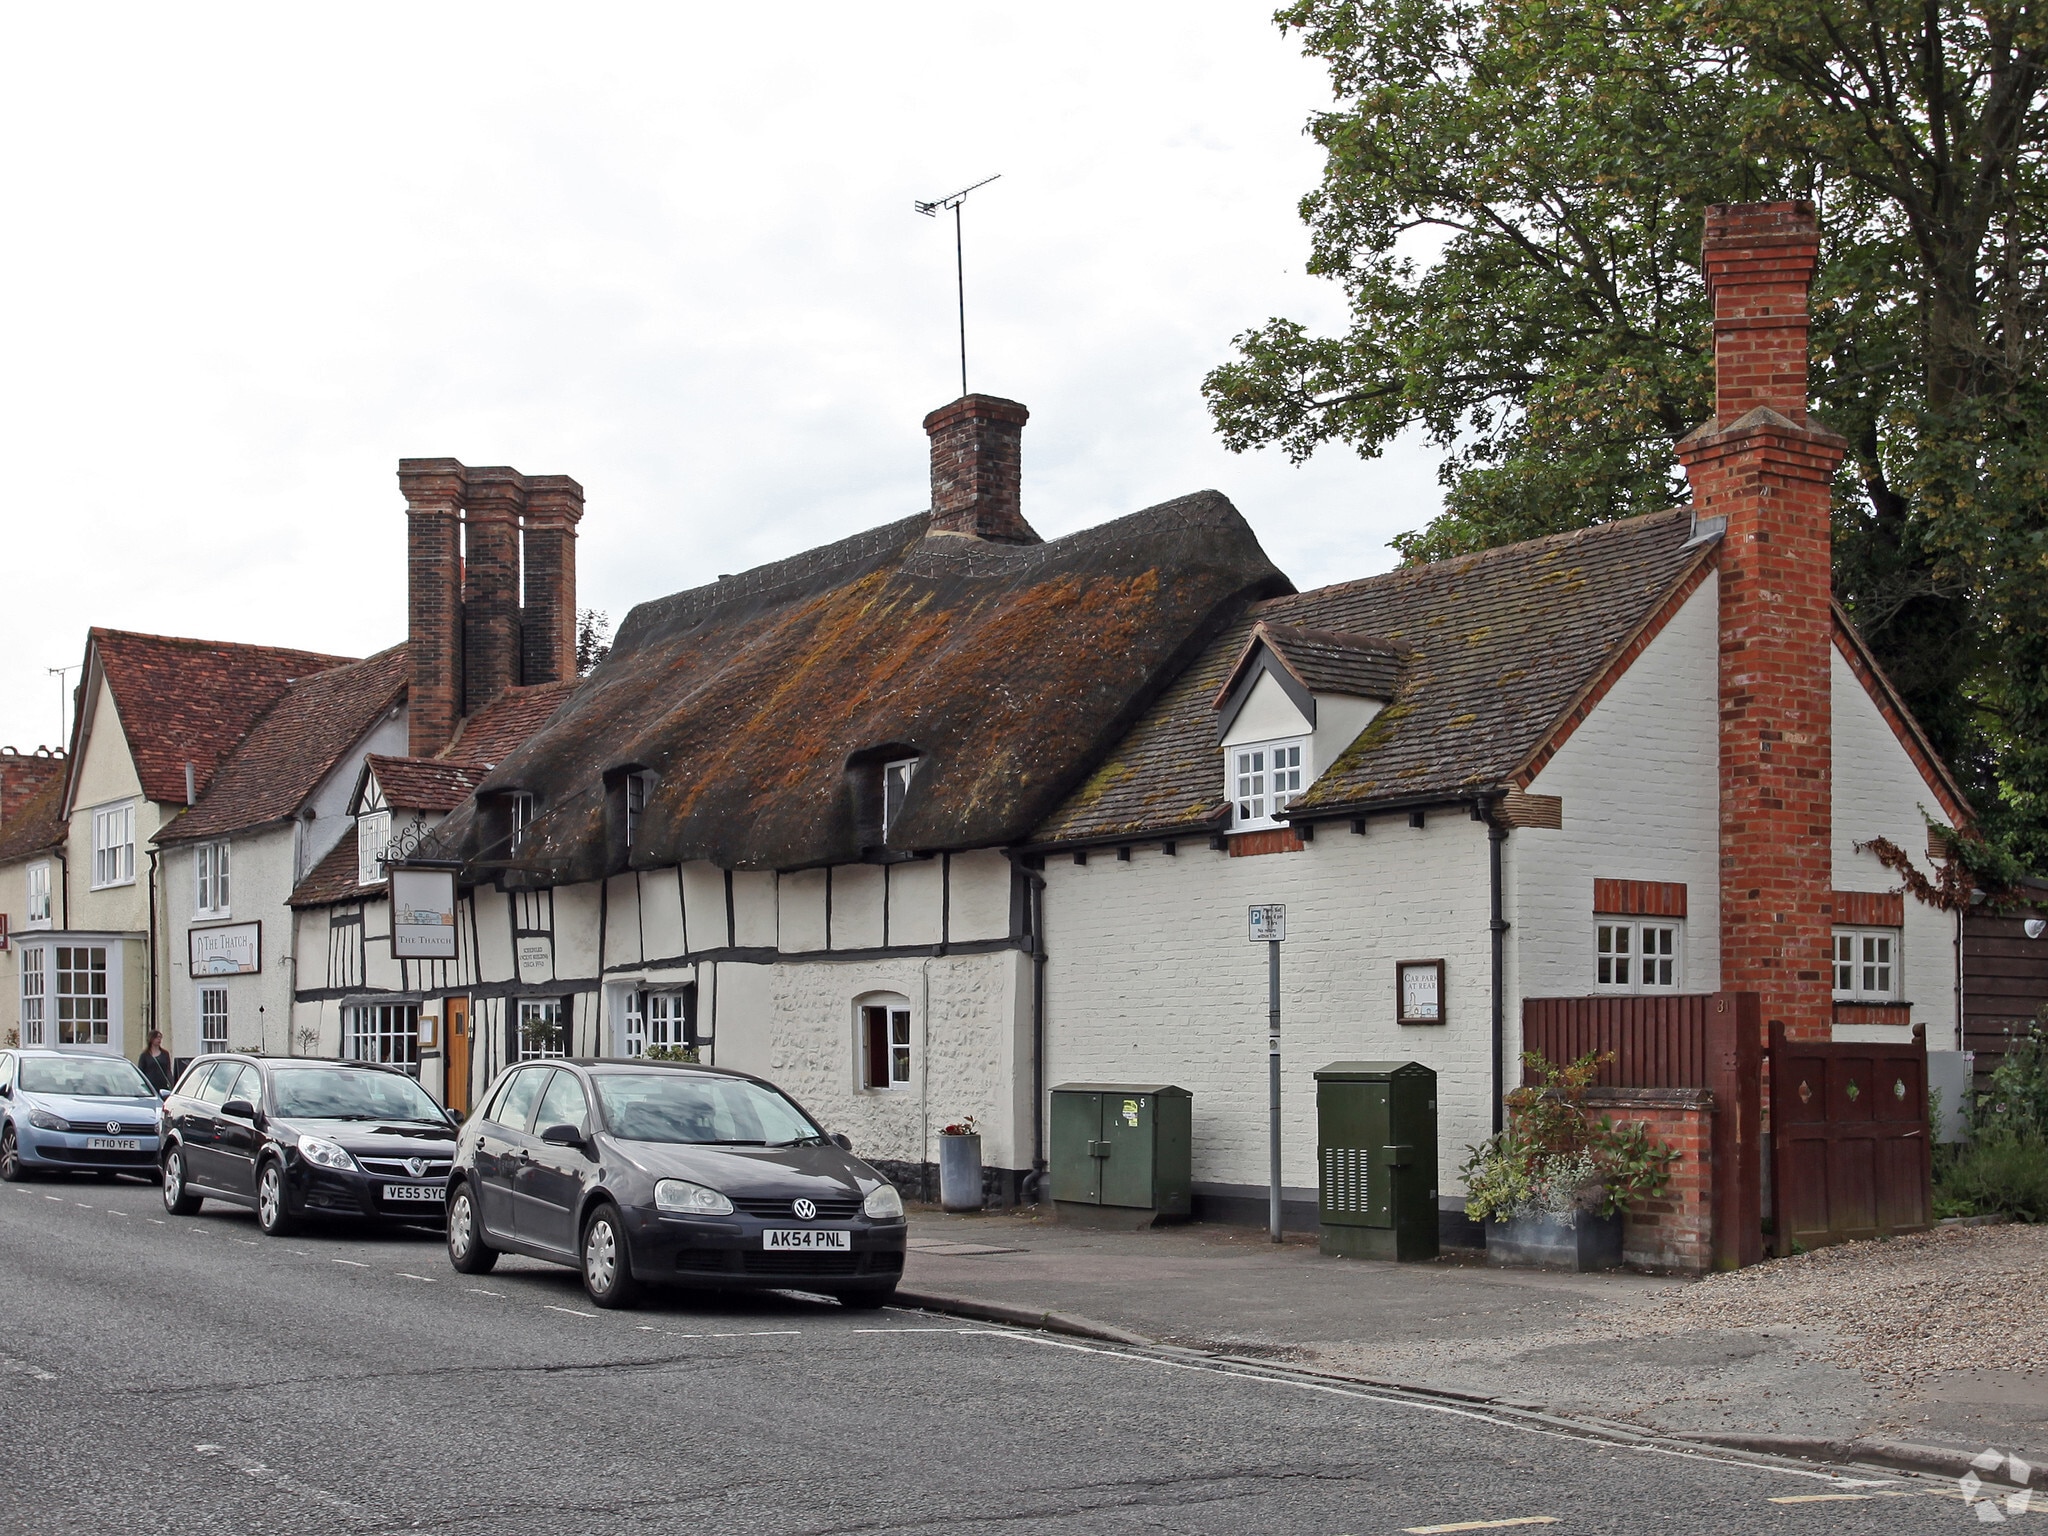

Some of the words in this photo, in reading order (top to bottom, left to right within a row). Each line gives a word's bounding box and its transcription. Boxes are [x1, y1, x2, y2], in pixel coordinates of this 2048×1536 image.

[203, 936, 218, 950] THE
[220, 933, 248, 949] THATCH
[398, 935, 416, 944] THE
[418, 936, 452, 944] THATCH
[1404, 973, 1419, 982] CAR
[1408, 982, 1417, 990] AT
[1418, 982, 1436, 990] REAR
[1140, 1098, 1145, 1107] 5
[94, 1139, 115, 1148] FT10
[118, 1140, 135, 1149] YFE
[390, 1187, 420, 1199] VE55
[771, 1231, 812, 1247] AK54
[816, 1232, 845, 1247] PNL
